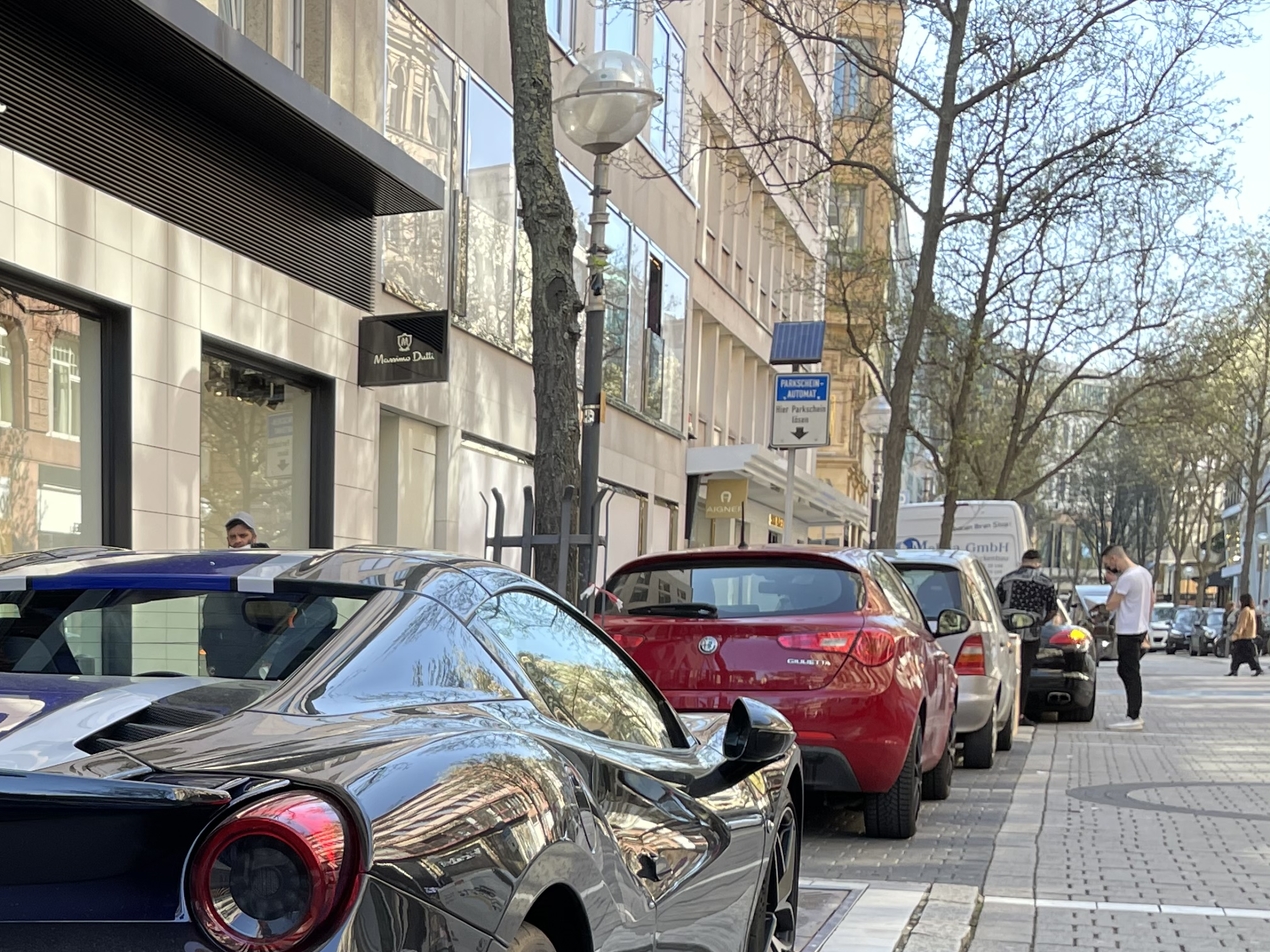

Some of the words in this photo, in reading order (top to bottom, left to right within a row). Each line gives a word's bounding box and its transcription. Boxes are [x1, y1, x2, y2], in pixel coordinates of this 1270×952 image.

[373, 353, 411, 365] Massimo
[412, 350, 435, 362] Dutti
[780, 378, 824, 388] PARKSCHEIN-
[787, 389, 817, 399] AUTOMAT
[775, 405, 789, 413] Hier
[791, 404, 826, 413] Parkschein
[965, 541, 1009, 553] GmbH
[786, 658, 831, 666] GIULIETTA
